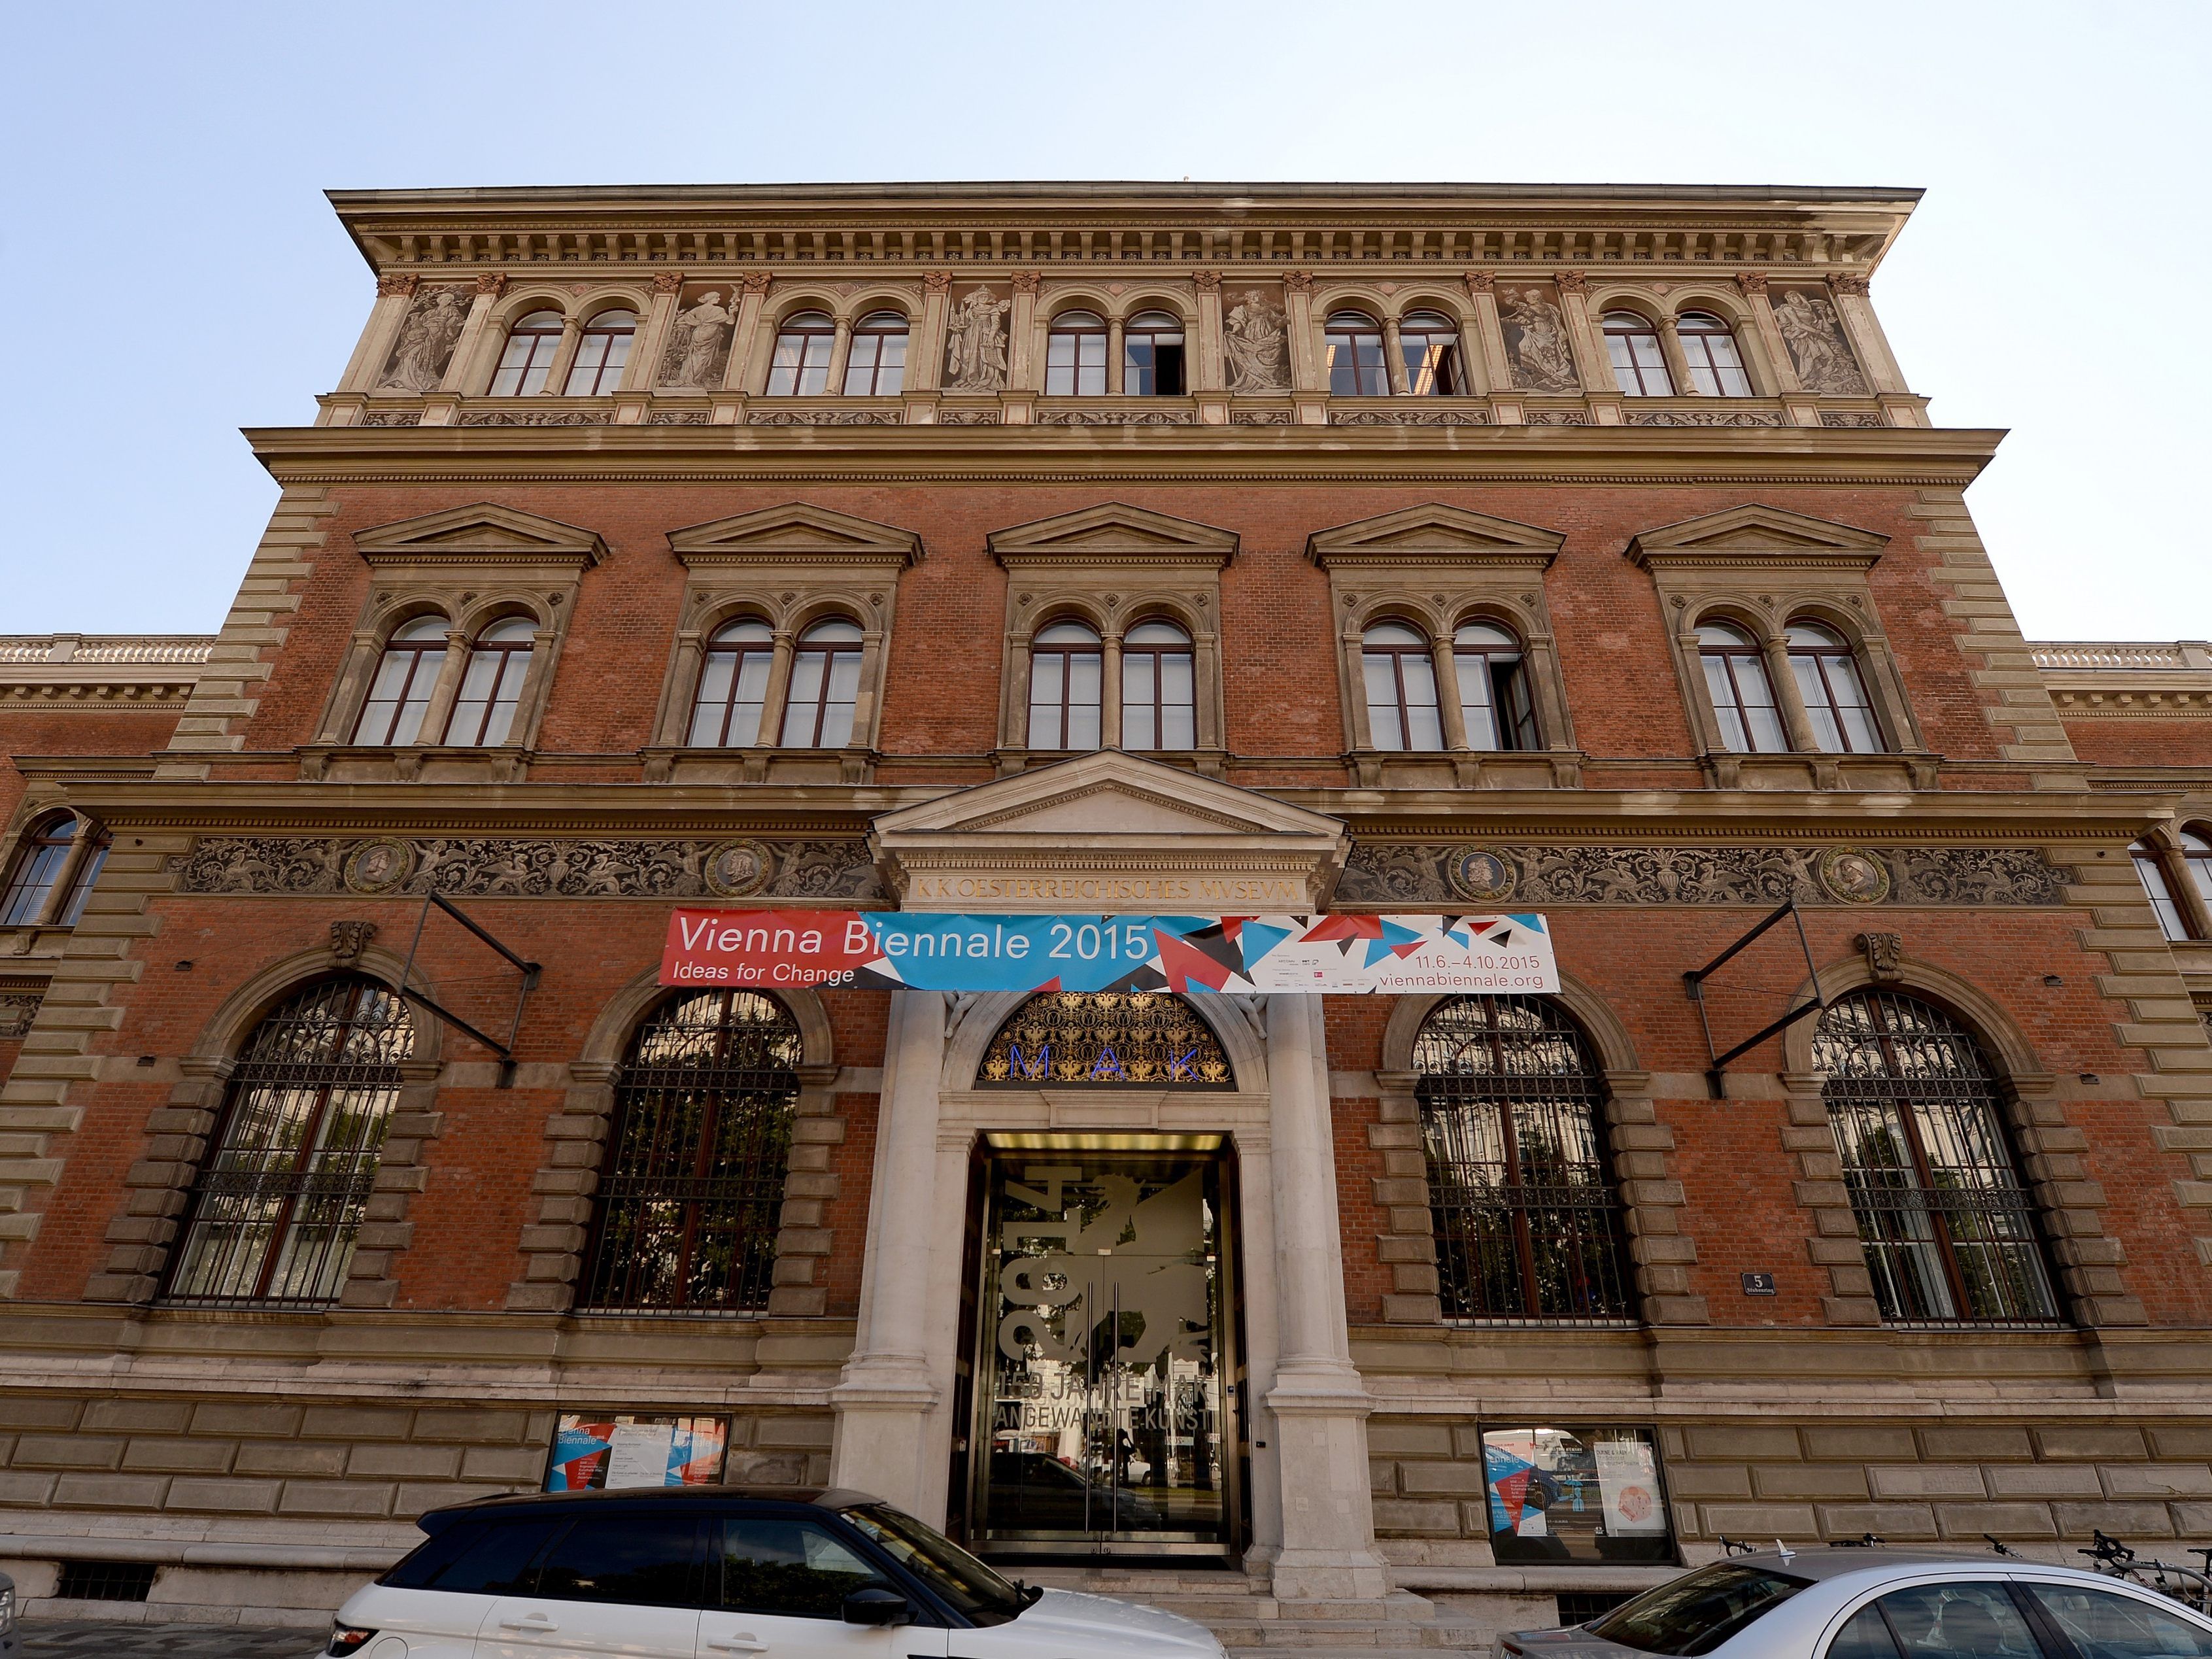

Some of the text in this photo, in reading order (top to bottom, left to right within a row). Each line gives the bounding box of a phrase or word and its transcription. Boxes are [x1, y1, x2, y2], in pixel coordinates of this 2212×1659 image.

[957, 879, 1190, 899] OESTERREICHISCHES
[680, 916, 1148, 959] Vienna Biennale 2015
[673, 961, 854, 986] Ideas for Change
[1380, 972, 1543, 989] viennabiennale.org
[1754, 1275, 1763, 1288] 5
[998, 1371, 1210, 1403] 150 JAHRE MAK
